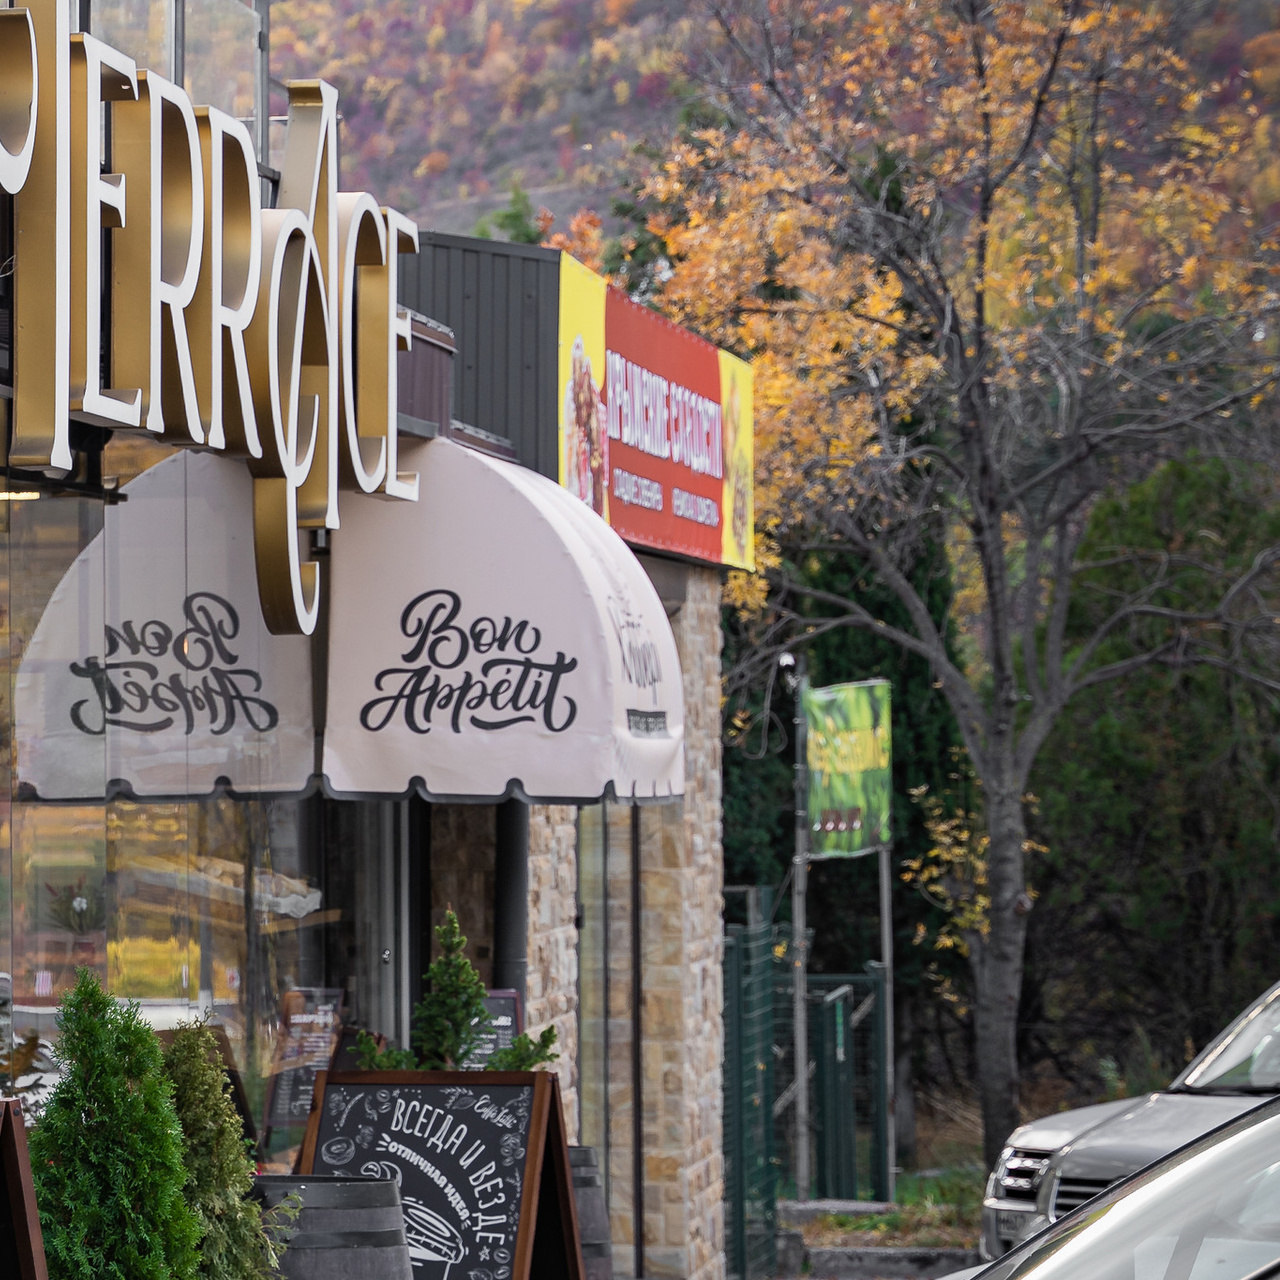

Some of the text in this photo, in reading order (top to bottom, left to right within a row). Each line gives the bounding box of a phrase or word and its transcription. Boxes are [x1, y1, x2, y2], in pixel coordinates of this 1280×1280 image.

[401, 589, 541, 669] Bon
[388, 1141, 470, 1220] ОТЛИЧНАЯ ИДЕЯ
[390, 1097, 507, 1245] ВСЕГДА И ВЕЗДЕ
